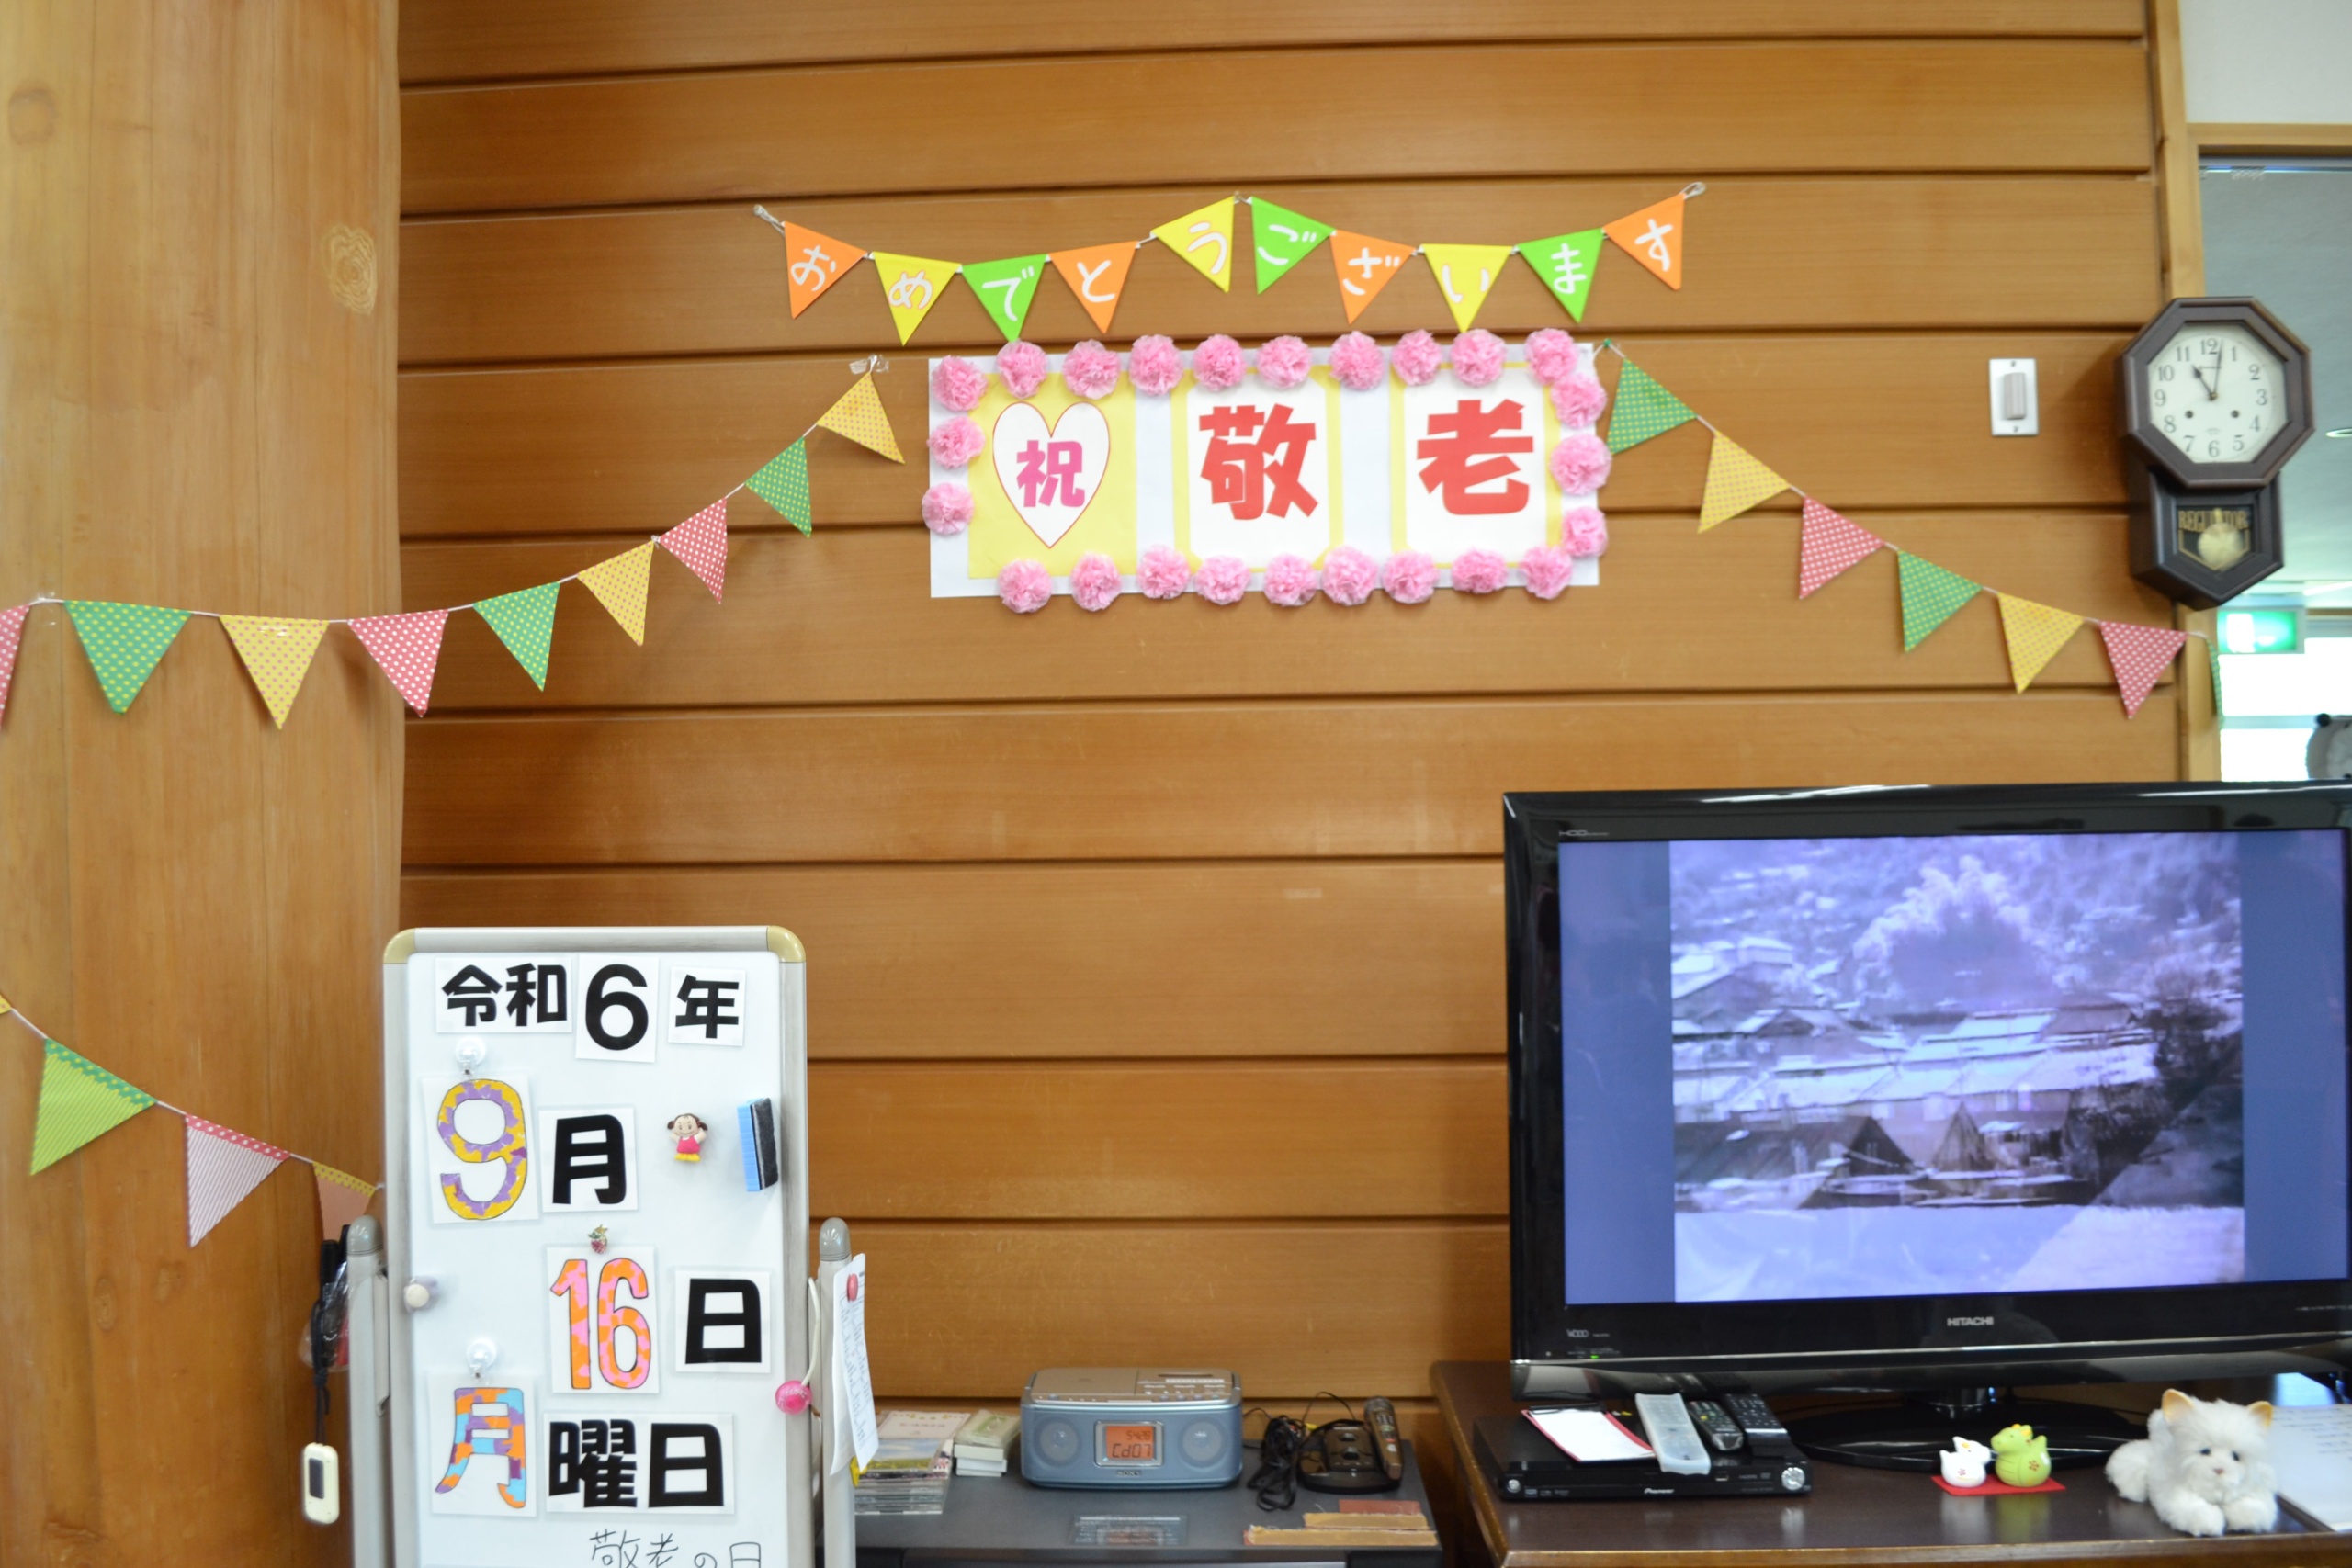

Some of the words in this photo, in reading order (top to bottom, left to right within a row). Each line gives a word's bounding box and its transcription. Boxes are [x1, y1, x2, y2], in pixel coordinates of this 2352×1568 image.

[791, 219, 1673, 321] おめでとうございます
[2177, 345, 2190, 362] 11
[2200, 337, 2218, 355] 12
[2158, 364, 2175, 381] 10
[2248, 364, 2260, 380] 2
[2154, 389, 2166, 407] 9
[2256, 389, 2267, 406] 3
[2164, 414, 2177, 434] 8
[2248, 415, 2261, 432] 4
[2183, 434, 2195, 452] 7
[2207, 440, 2220, 457] 6
[2232, 434, 2245, 451] 5
[1016, 440, 1085, 508] 祝
[1198, 399, 1534, 521] 敬老
[441, 963, 740, 1052] 令和6年
[436, 1078, 627, 1221] 9月
[549, 1257, 763, 1390] 16日
[1947, 1316, 1995, 1326] HITACHI
[435, 1386, 725, 1509] 月曜日
